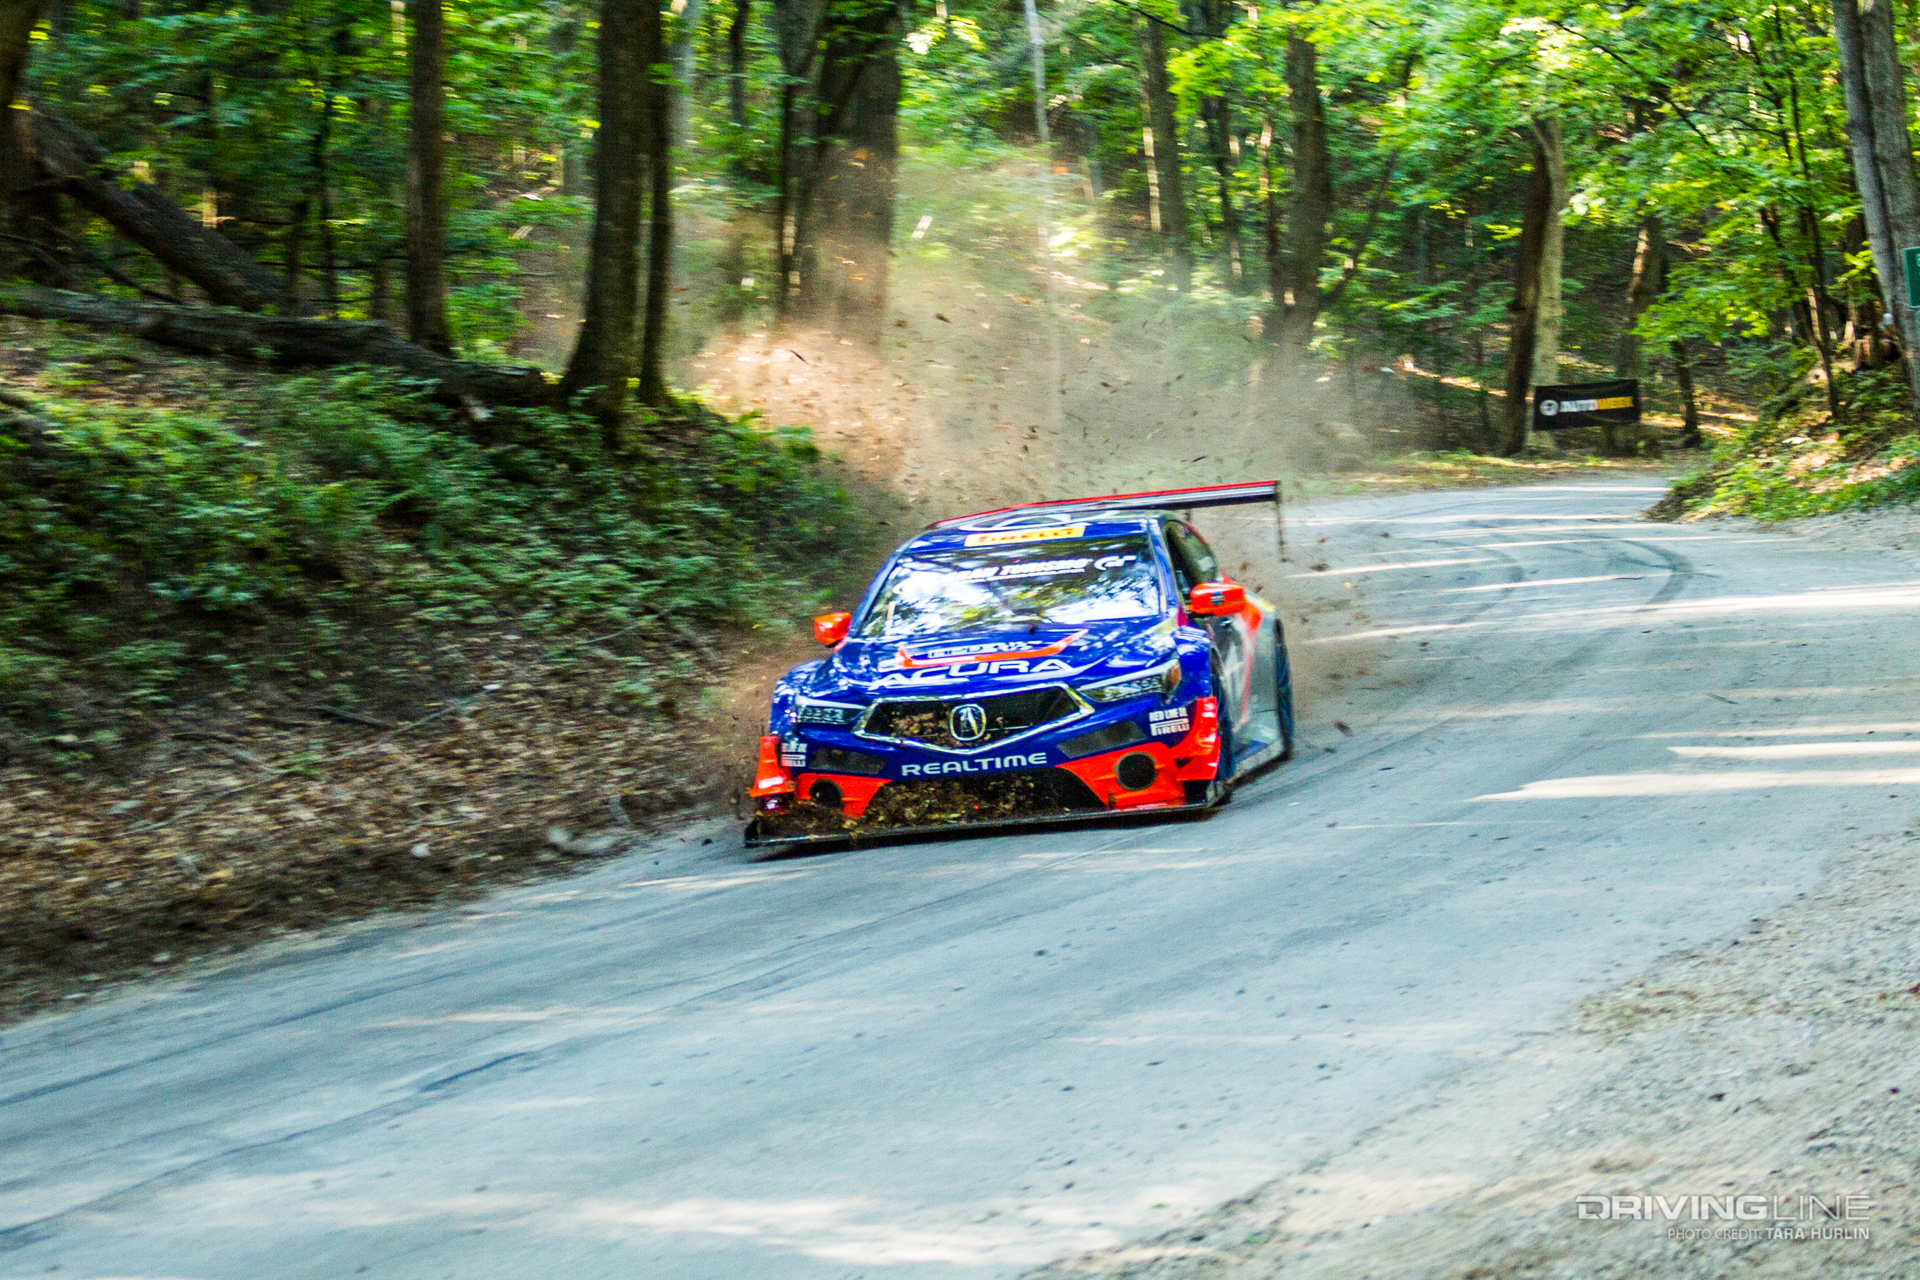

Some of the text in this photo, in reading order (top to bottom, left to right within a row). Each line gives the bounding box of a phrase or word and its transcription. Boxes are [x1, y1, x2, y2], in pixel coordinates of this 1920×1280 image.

[868, 658, 1075, 691] ACURA
[1150, 718, 1190, 736] PIRELLI
[901, 752, 1048, 776] REALTIME
